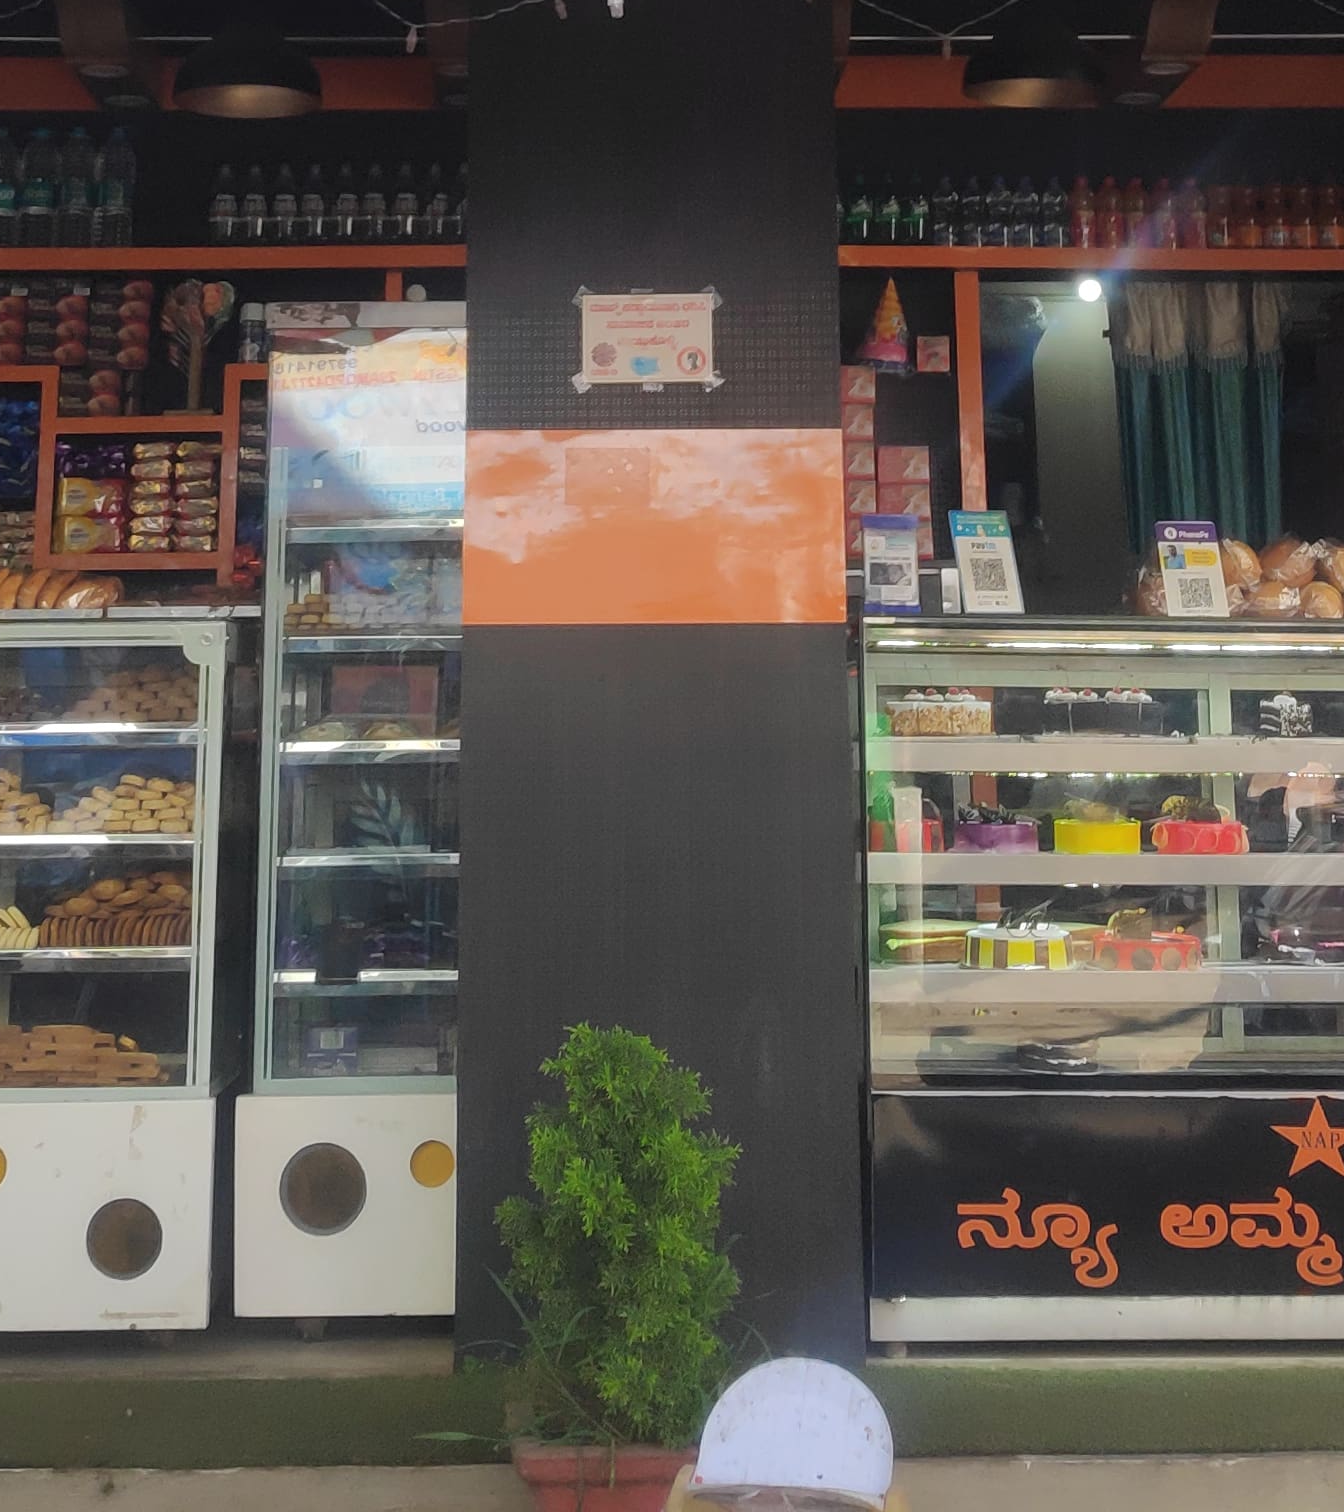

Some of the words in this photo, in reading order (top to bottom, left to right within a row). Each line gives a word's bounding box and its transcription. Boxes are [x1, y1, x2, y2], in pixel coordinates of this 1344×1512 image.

[1301, 1131, 1341, 1149] NAP
[955, 1186, 1120, 1289] ನ್ಯೂ
[1159, 1186, 1344, 1287] ಅಮ್ಮ
